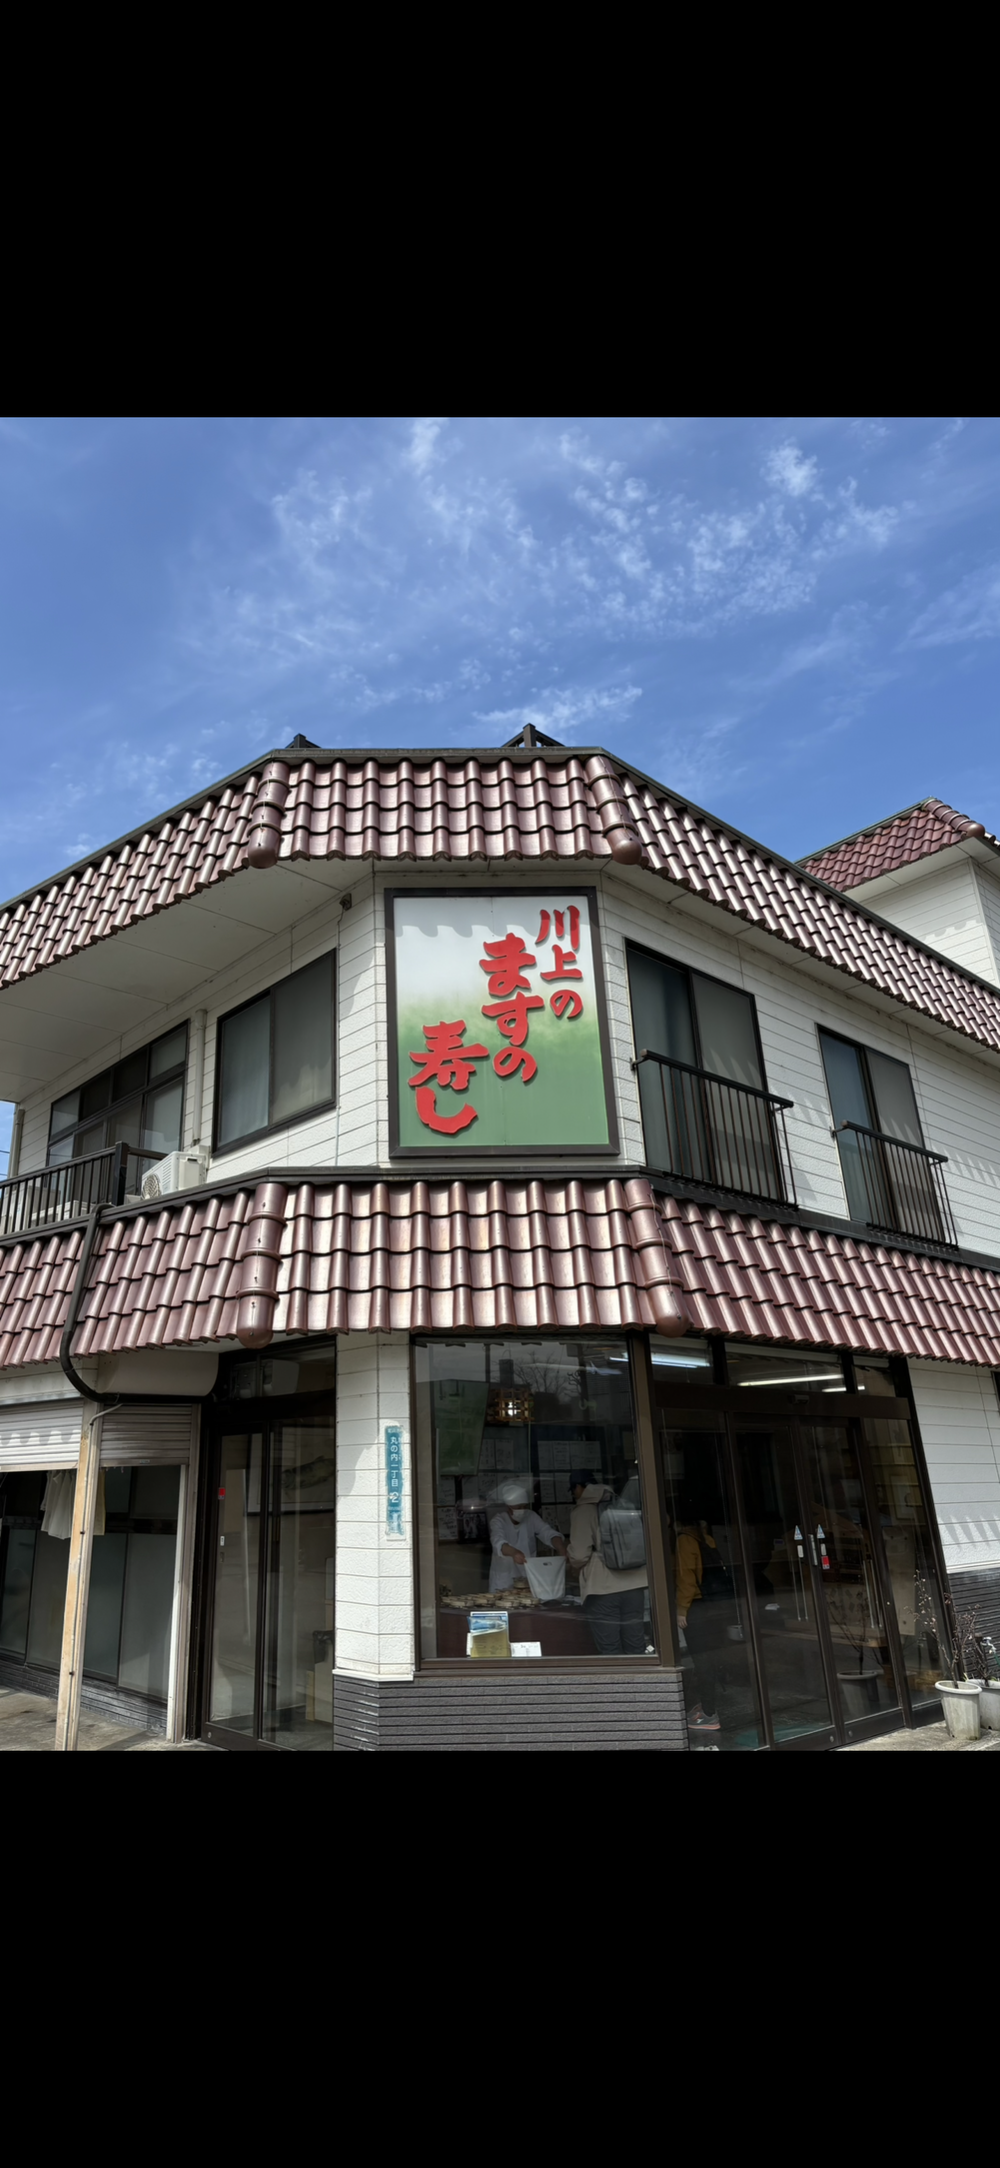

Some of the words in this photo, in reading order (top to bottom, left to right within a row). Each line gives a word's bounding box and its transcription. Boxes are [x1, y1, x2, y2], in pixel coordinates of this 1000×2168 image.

[479, 932, 544, 1082] ますの
[535, 905, 583, 1019] 川上の
[408, 1020, 489, 1133] 寿し
